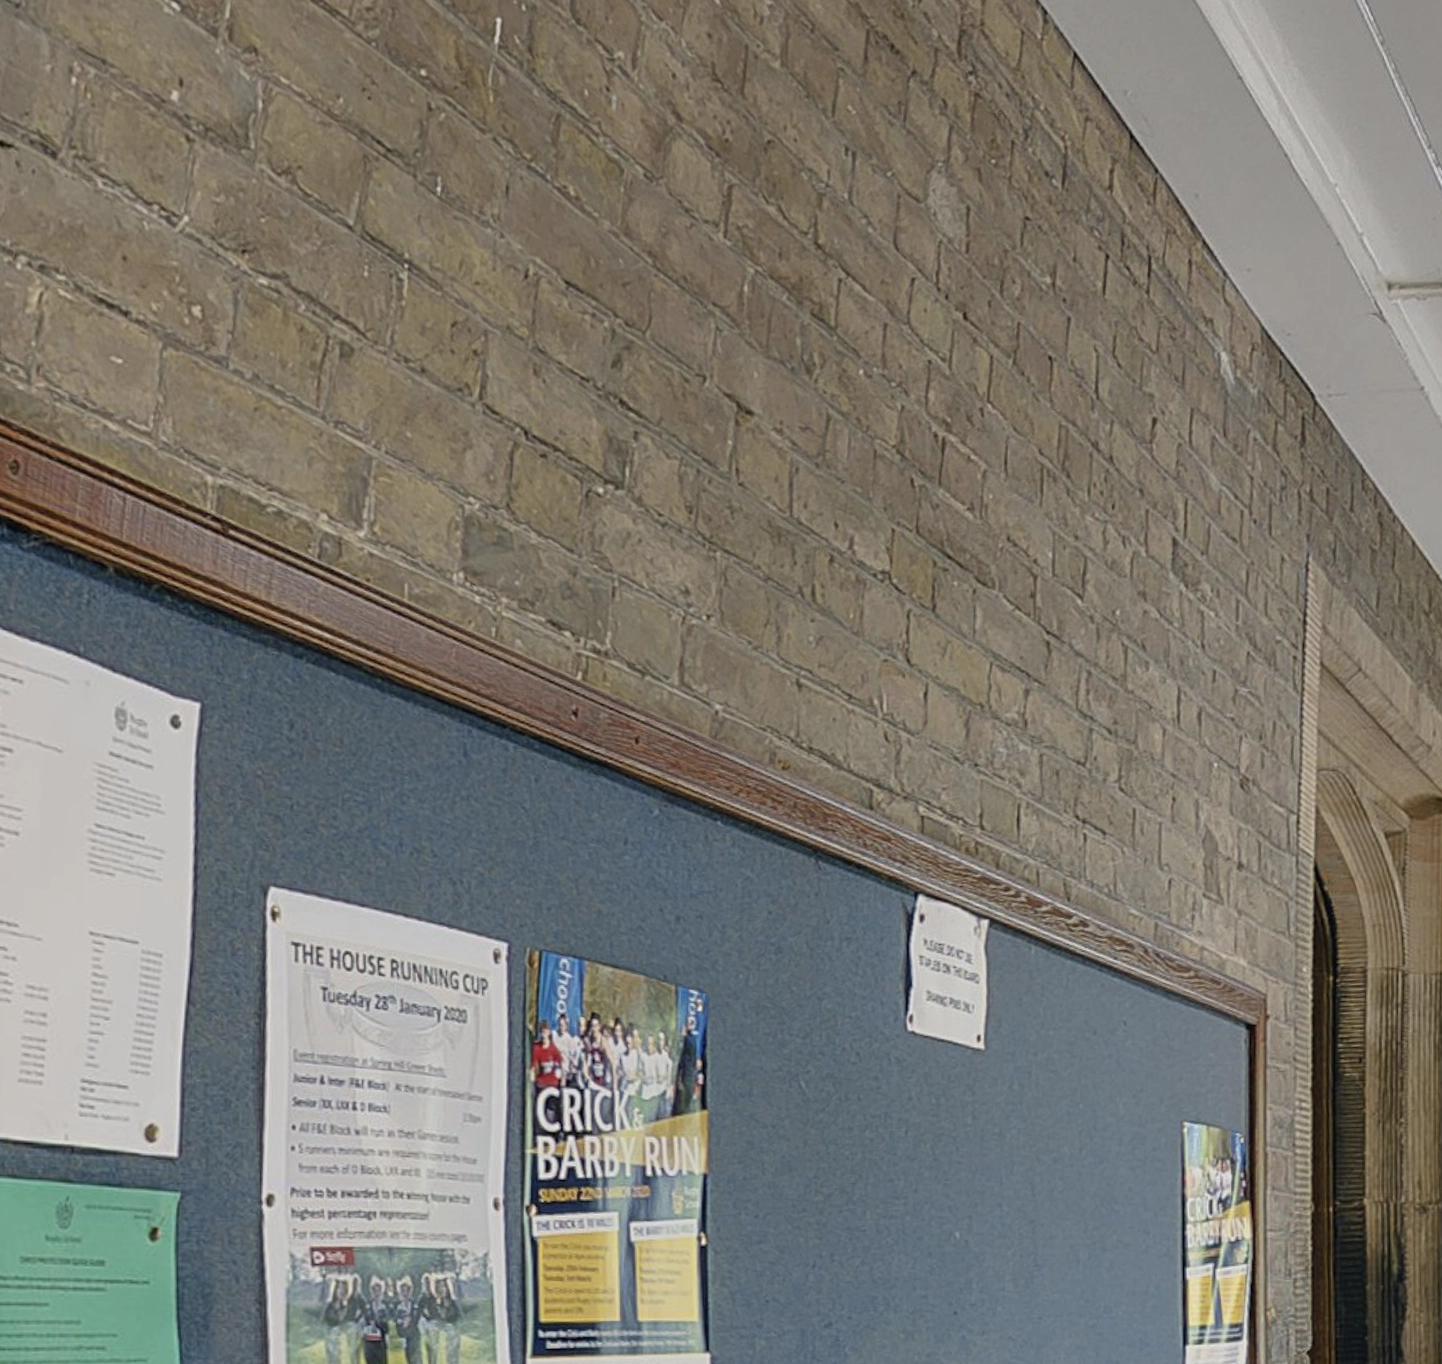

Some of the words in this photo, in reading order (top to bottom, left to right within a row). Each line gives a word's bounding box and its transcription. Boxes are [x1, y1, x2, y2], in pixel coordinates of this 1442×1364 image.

[291, 941, 325, 967] THE
[330, 948, 386, 977] HOUSE
[390, 959, 459, 990] RUNNING
[463, 973, 489, 996] CUP
[320, 987, 372, 1012] Tuesday
[399, 998, 442, 1023] January
[444, 1006, 468, 1024] 2020
[536, 1086, 630, 1132] CRICK
[632, 1107, 644, 1130] &
[536, 1136, 637, 1180] BARBY
[644, 1136, 700, 1177] RUN
[538, 1187, 579, 1203] SUNDAY
